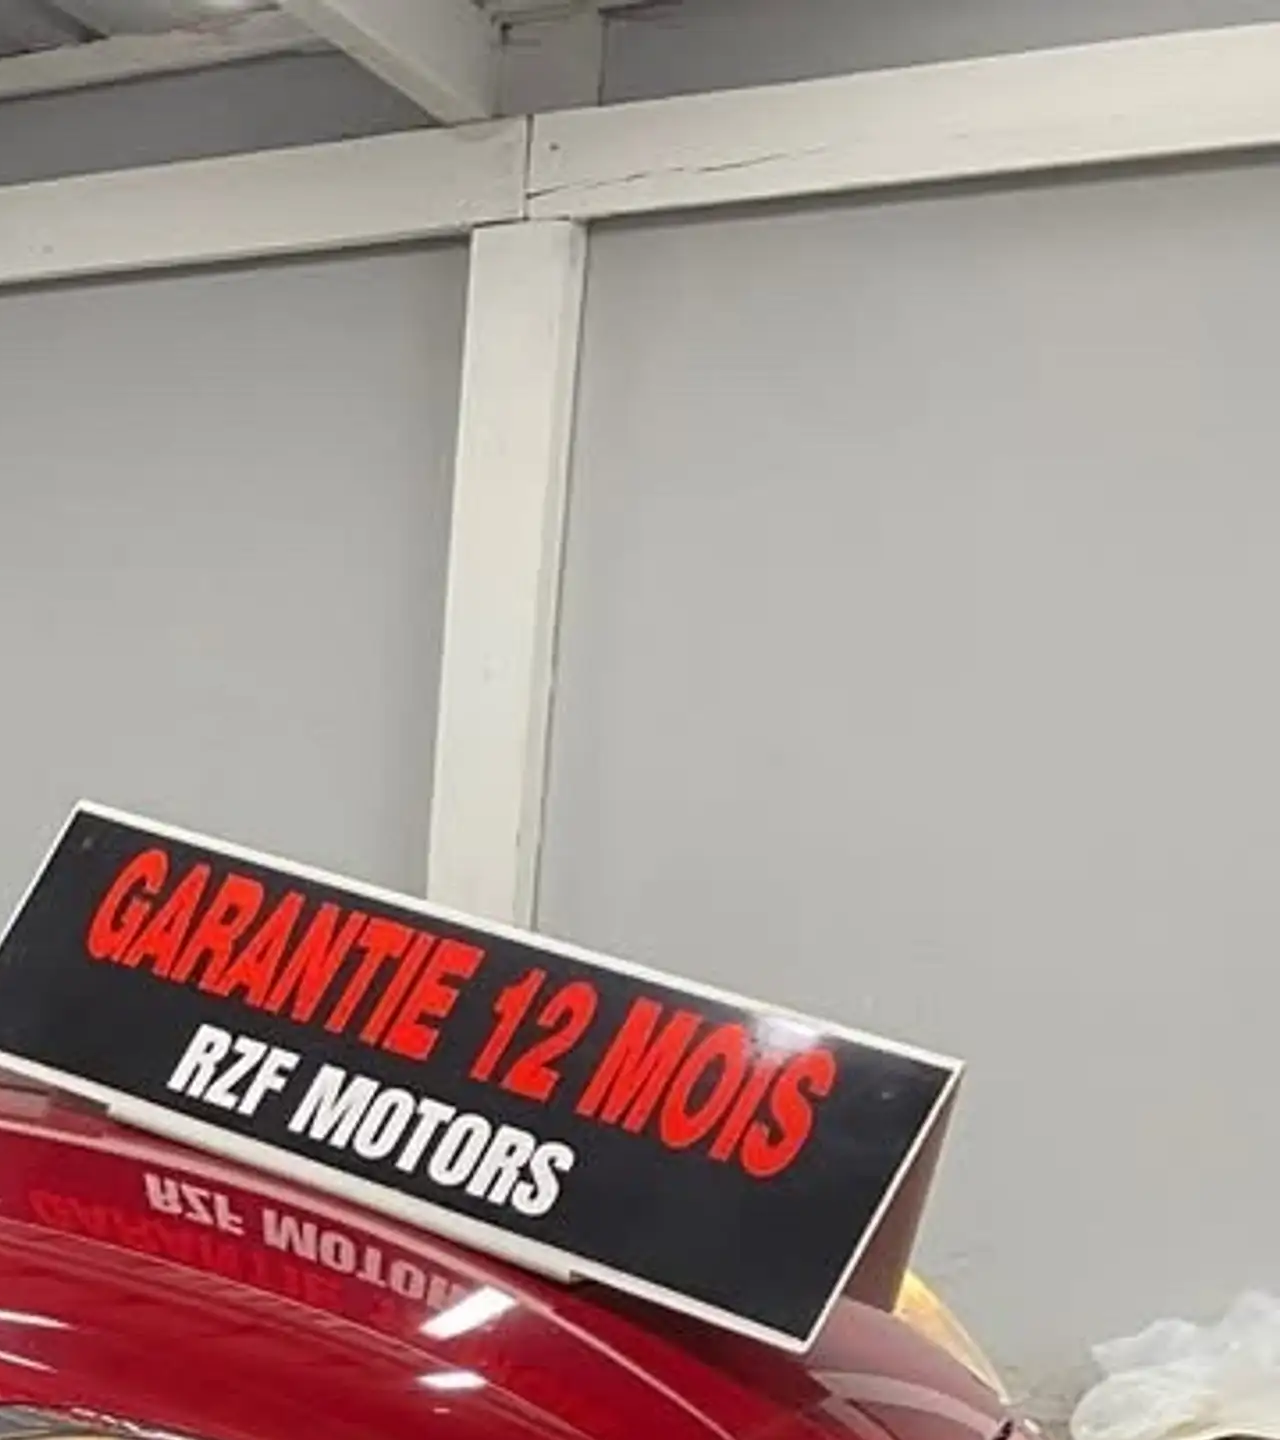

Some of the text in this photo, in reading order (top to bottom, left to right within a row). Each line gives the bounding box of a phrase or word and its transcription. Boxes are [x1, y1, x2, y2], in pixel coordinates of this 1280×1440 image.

[88, 849, 837, 1177] GARANTIE 12 MOIS
[166, 1022, 576, 1217] RZF MOTORS
